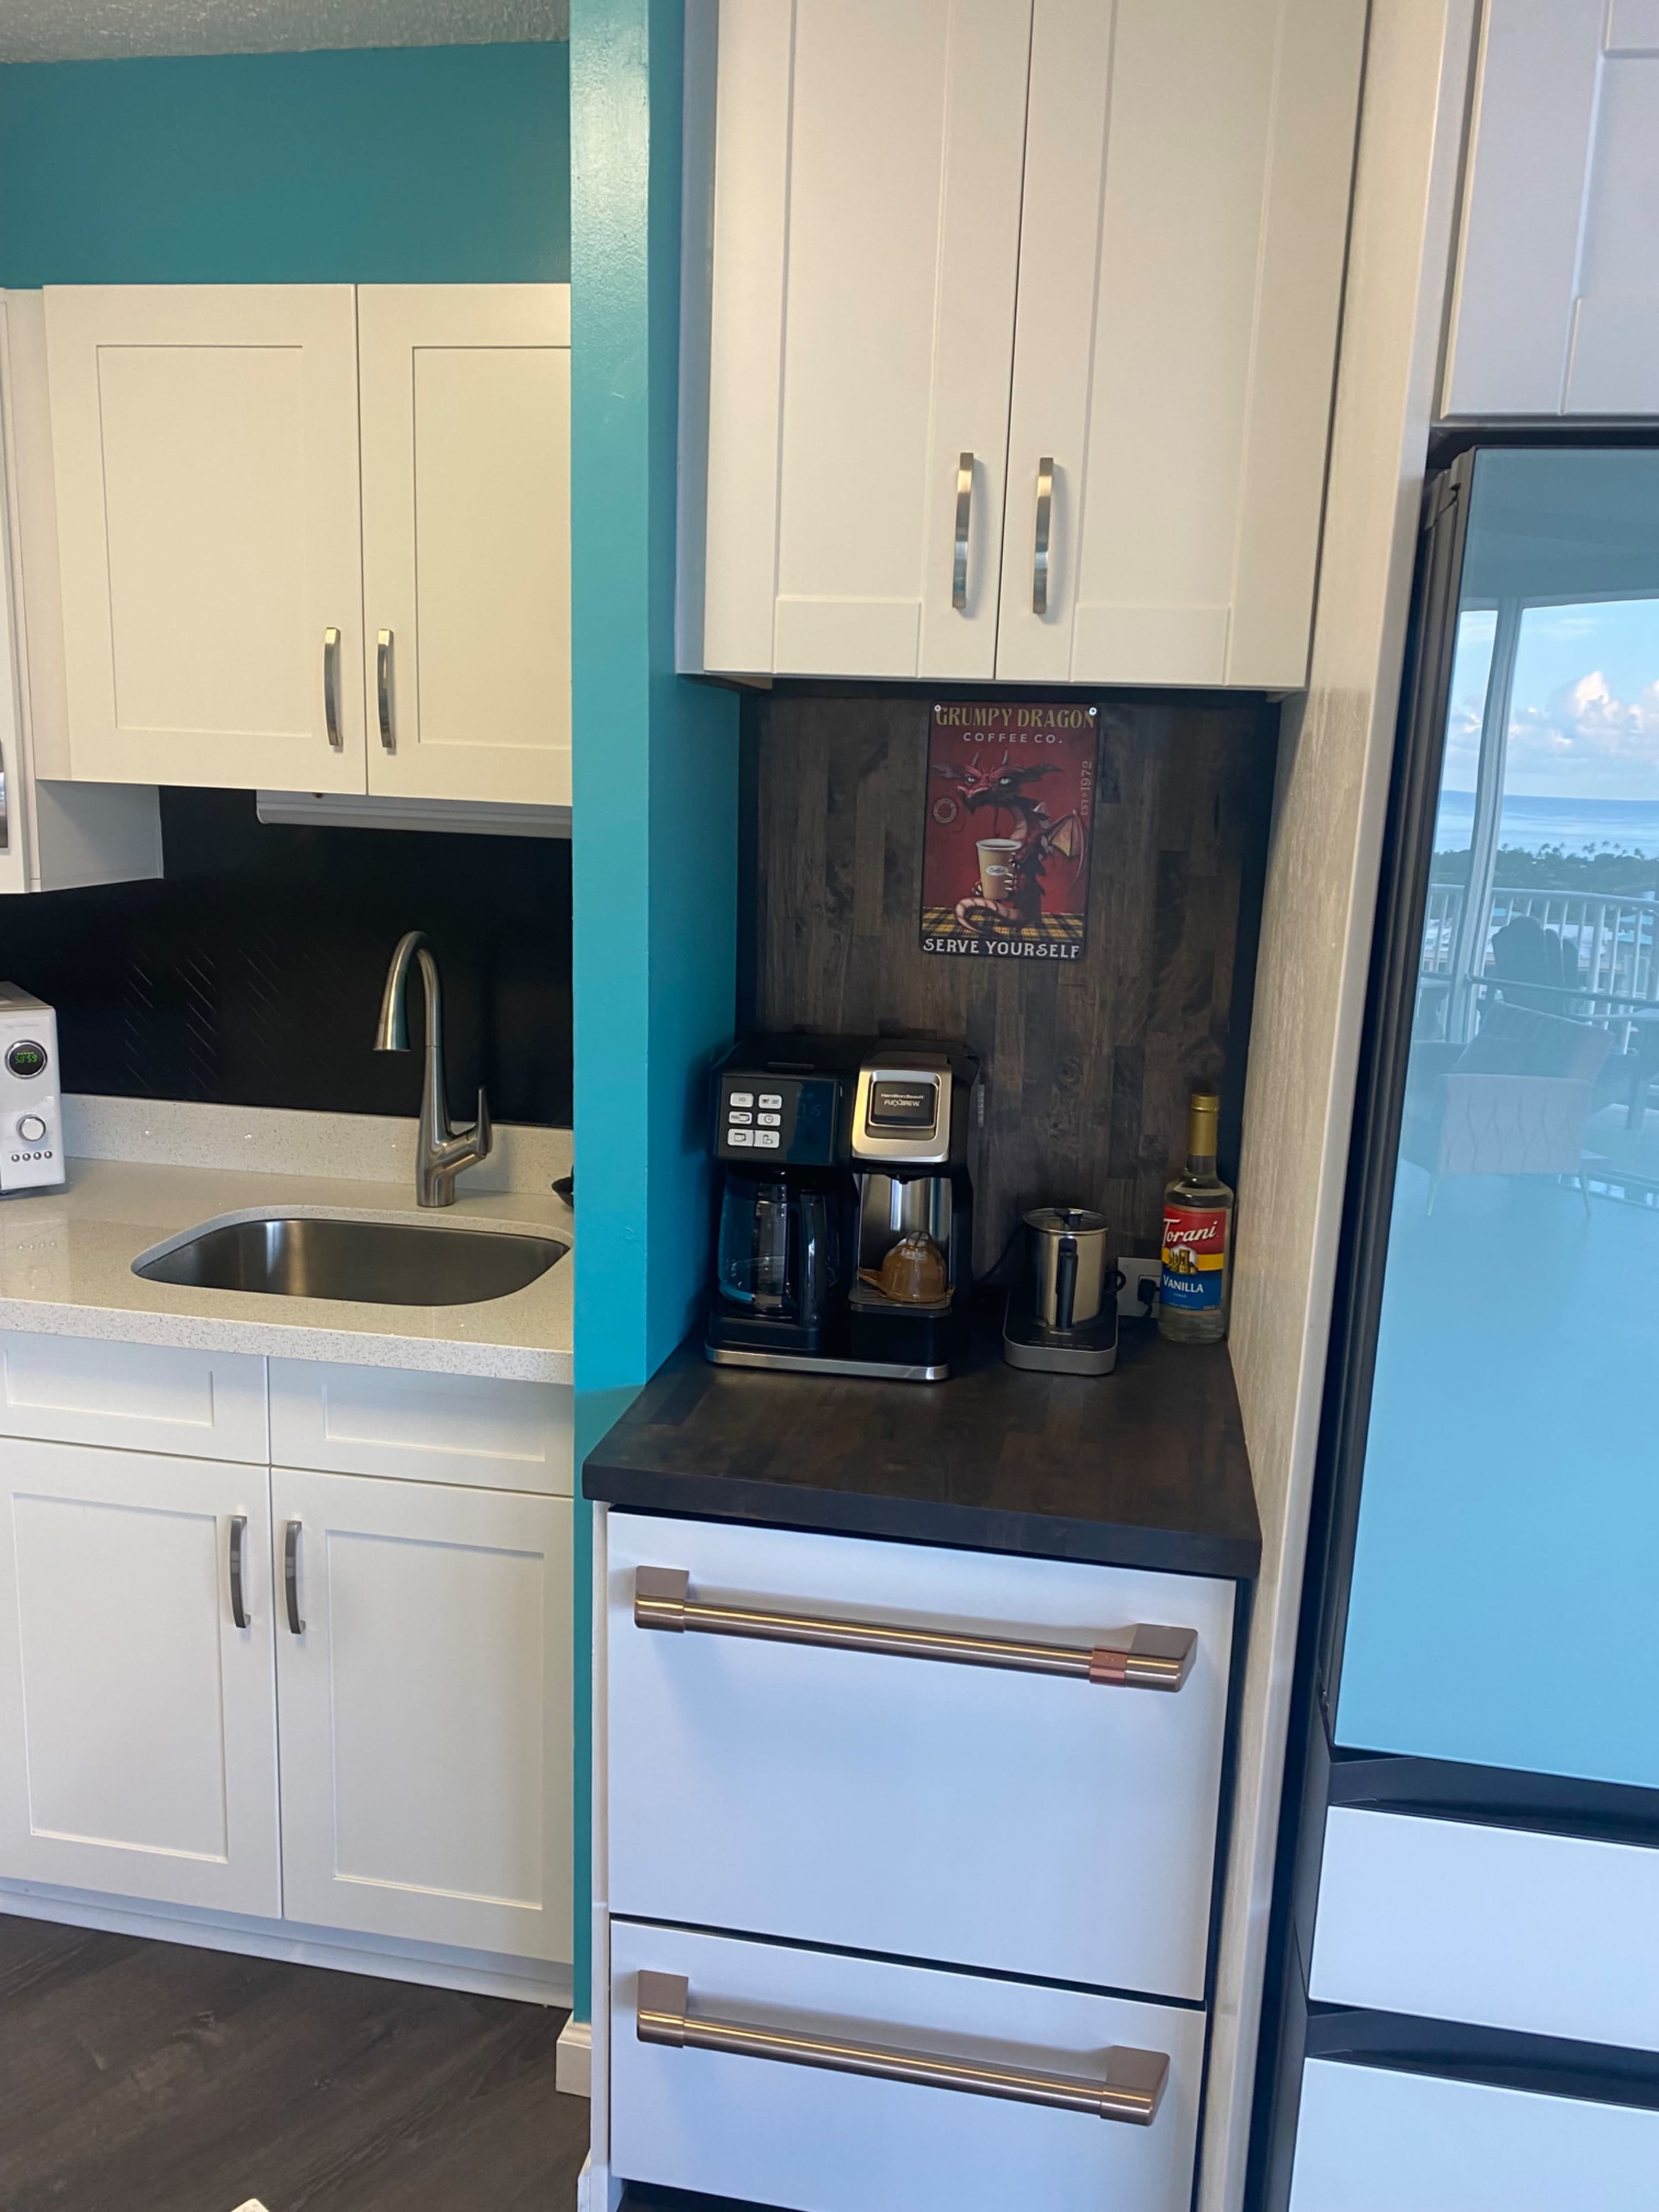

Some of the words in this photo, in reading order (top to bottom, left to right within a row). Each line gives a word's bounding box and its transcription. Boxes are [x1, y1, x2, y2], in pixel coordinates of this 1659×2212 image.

[935, 707, 1012, 727] GRUMPY
[1017, 708, 1094, 728] DRAGON
[963, 732, 1027, 743] COFFEE
[1034, 734, 1063, 744] CO.
[1081, 761, 1092, 790] 1972
[923, 938, 979, 953] SERVE
[985, 941, 1079, 958] YOURSELF
[1162, 1217, 1218, 1247] Torani
[1163, 1274, 1204, 1293] VANILLA
